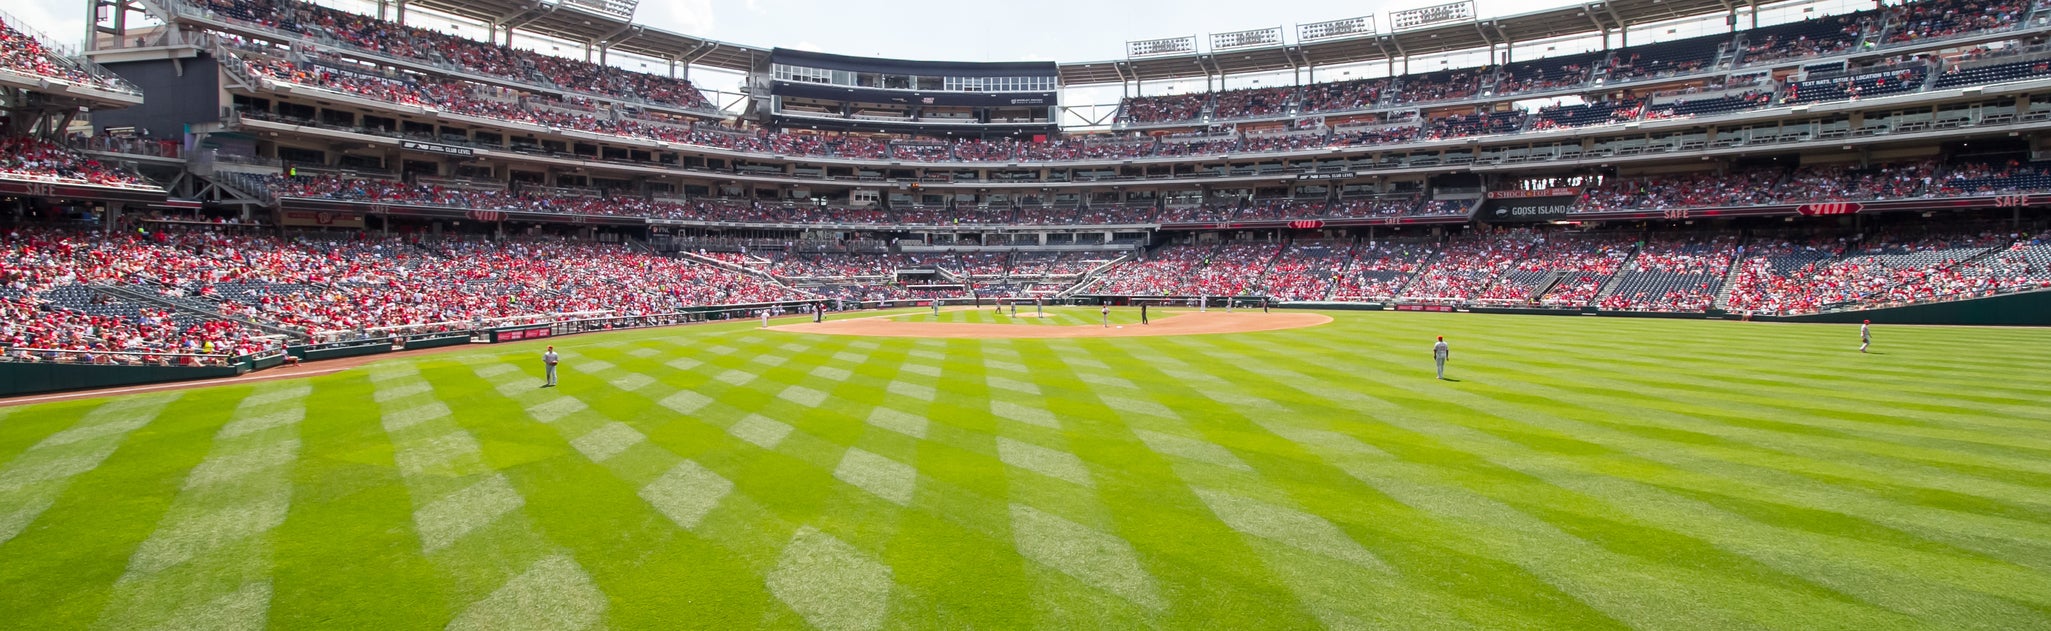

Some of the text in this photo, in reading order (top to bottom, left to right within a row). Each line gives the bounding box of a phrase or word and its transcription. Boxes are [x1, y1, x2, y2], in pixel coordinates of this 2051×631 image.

[1856, 72, 1881, 80] LOCATION
[26, 183, 56, 197] SAFE
[1497, 190, 1526, 198] SHOCK
[1533, 189, 1549, 197] TOP
[1995, 194, 2030, 207] SAFE
[1512, 205, 1566, 216] GOOSE ISLAND
[1664, 209, 1690, 219] SAFE
[1384, 217, 1400, 225] SAFE
